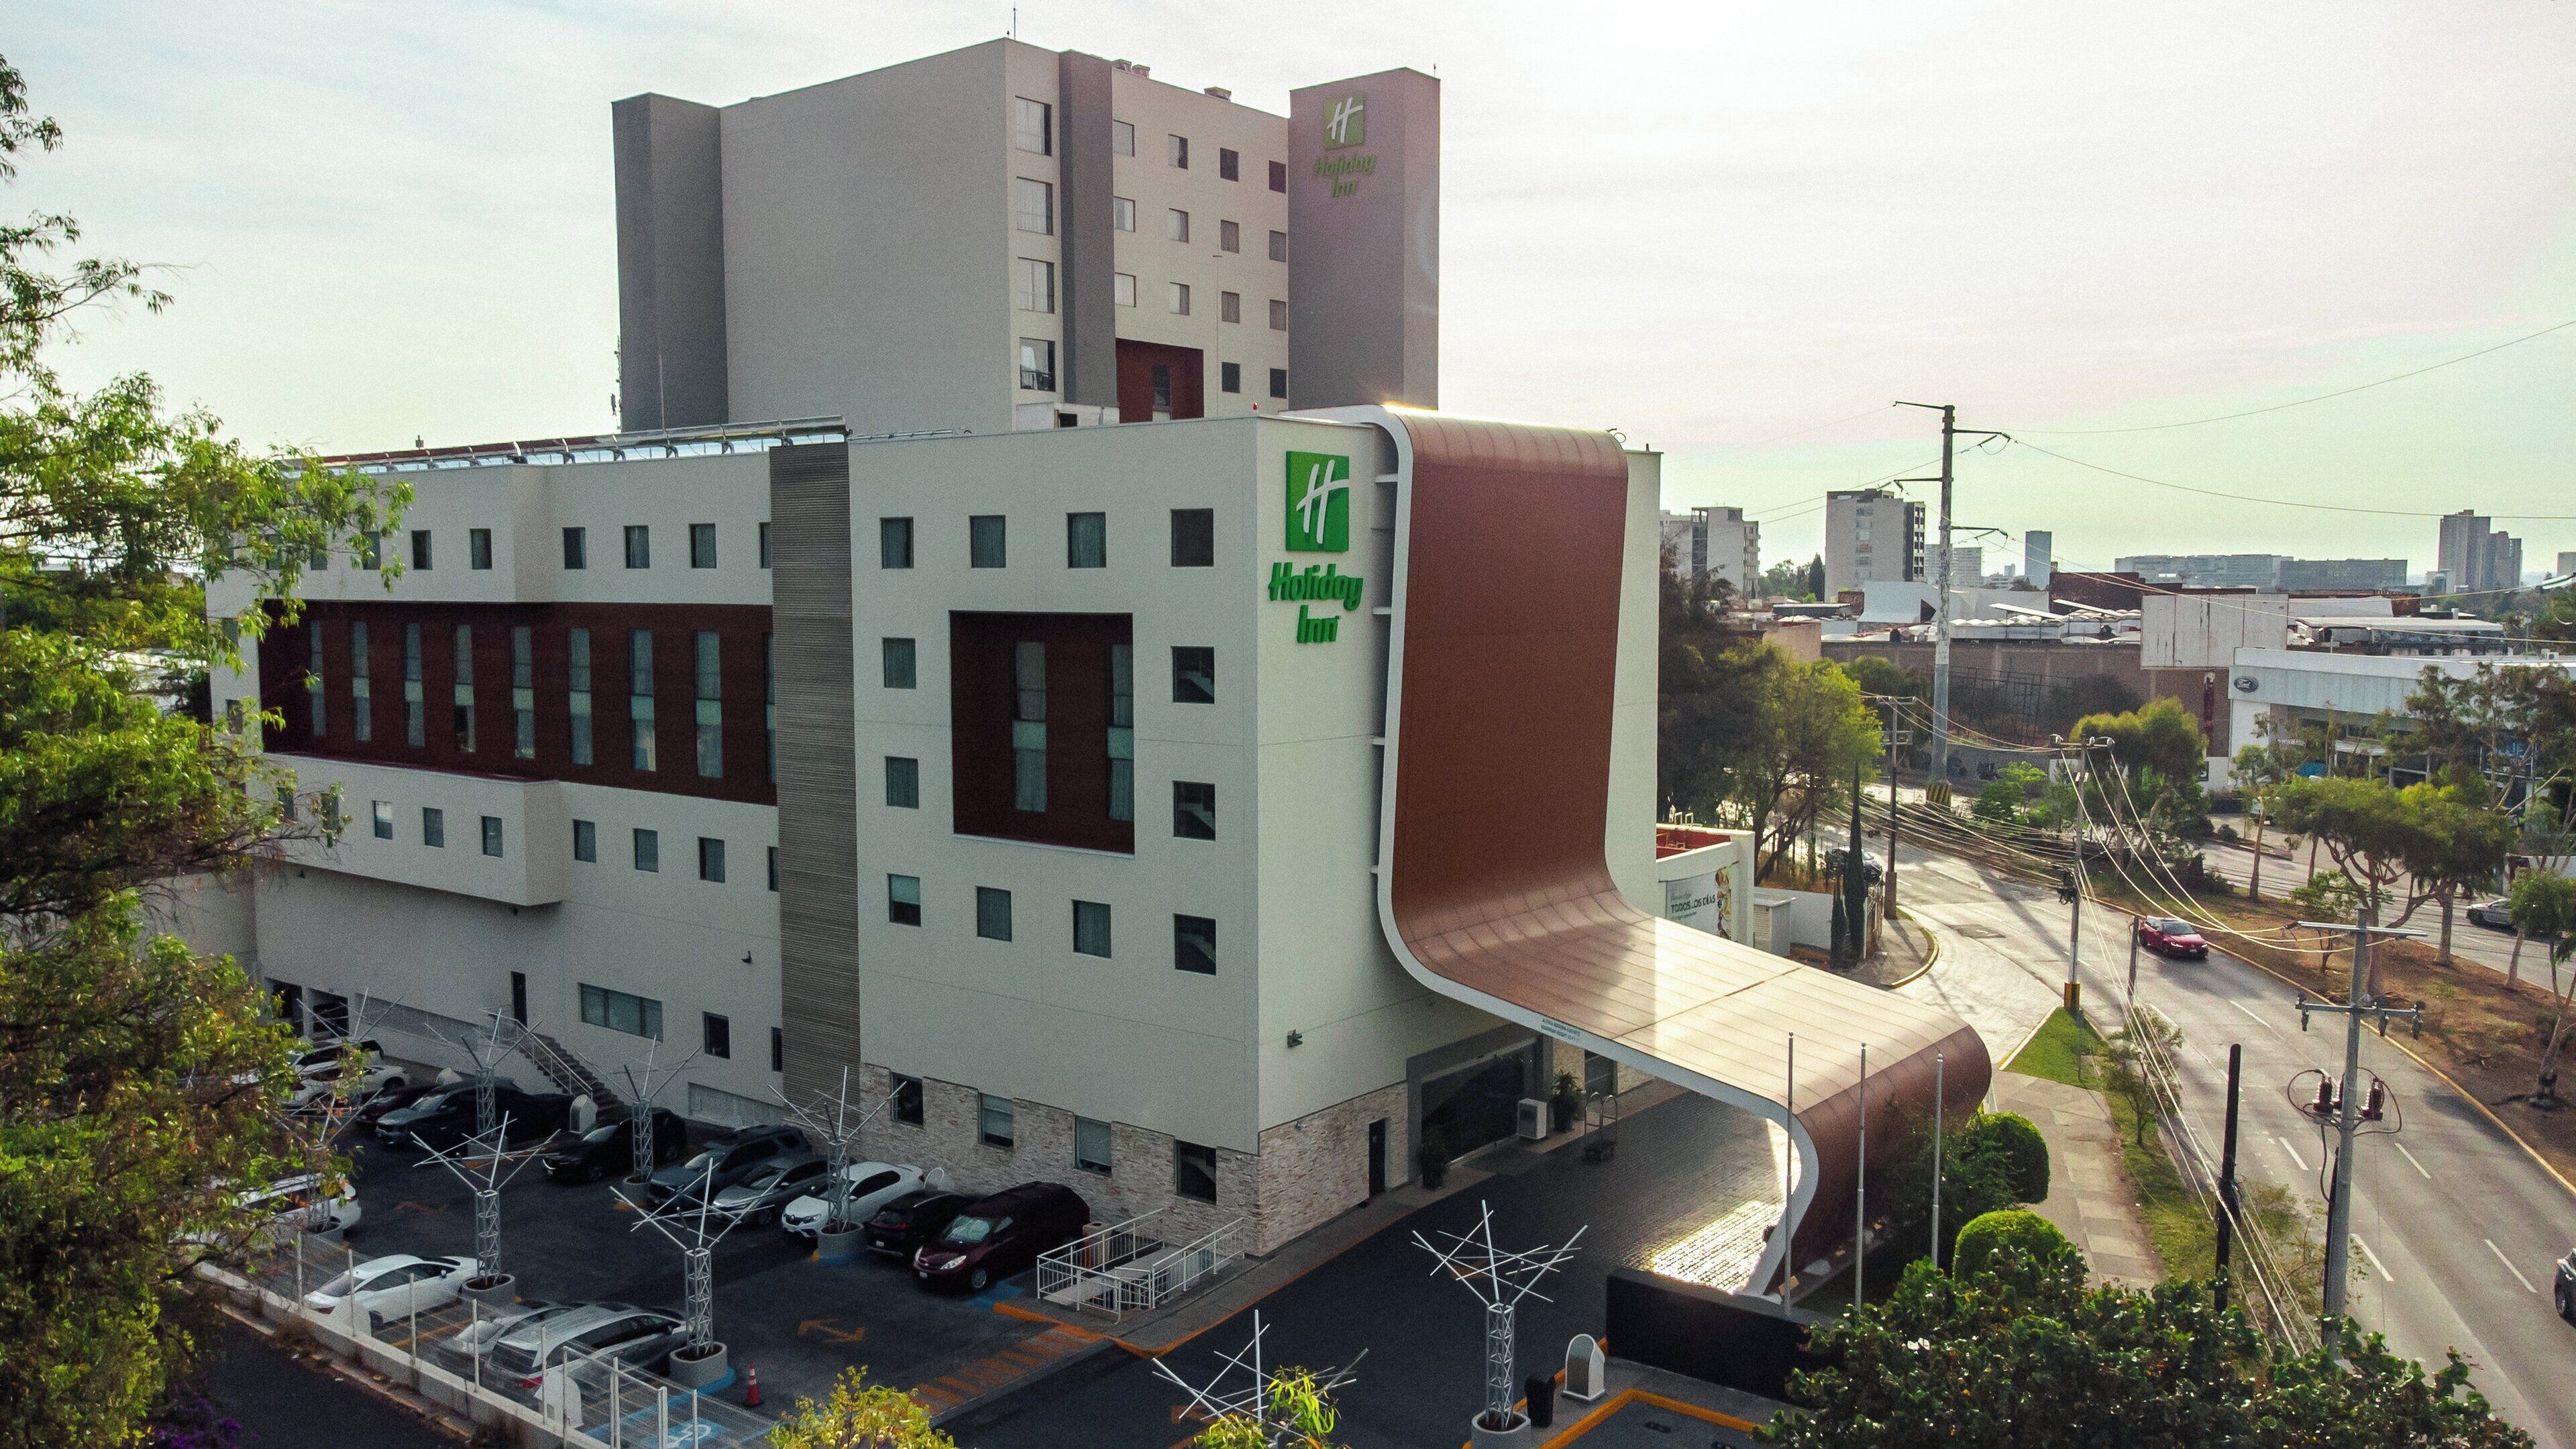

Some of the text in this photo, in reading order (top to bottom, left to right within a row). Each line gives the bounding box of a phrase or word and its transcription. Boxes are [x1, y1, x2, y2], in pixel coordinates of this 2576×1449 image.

[1315, 153, 1377, 176] Holiday
[1331, 176, 1357, 198] Inn
[1268, 562, 1363, 611] Holiday
[1297, 604, 1339, 643] Inn
